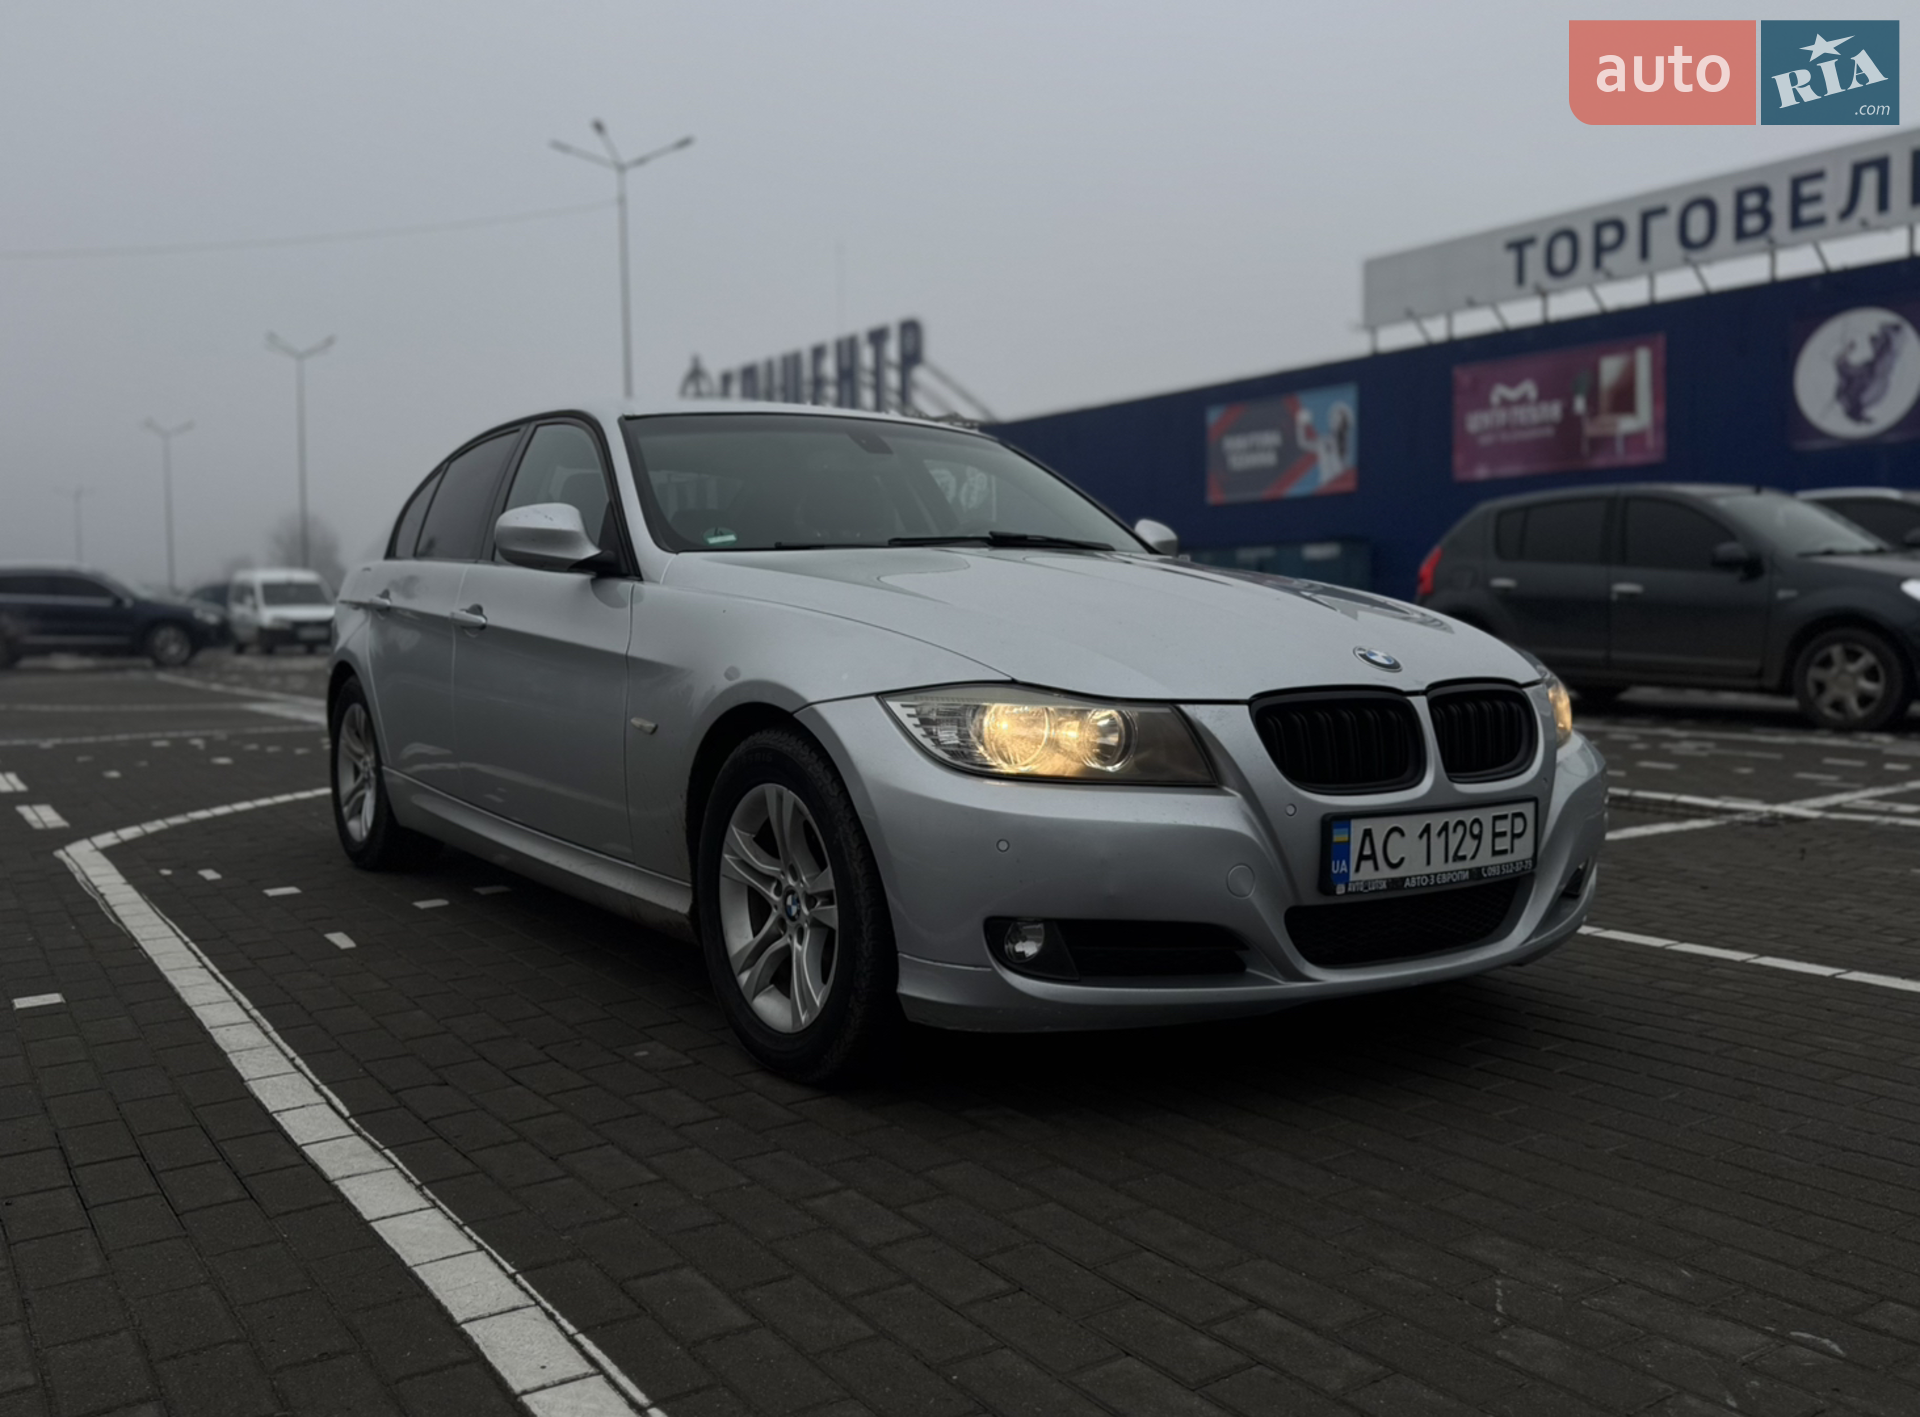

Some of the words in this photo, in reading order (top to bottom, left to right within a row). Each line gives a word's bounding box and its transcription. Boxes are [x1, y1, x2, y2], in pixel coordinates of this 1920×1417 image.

[1354, 826, 1406, 874] AC
[1418, 817, 1484, 866] 1129
[1491, 811, 1528, 857] EP
[1331, 860, 1348, 874] UA
